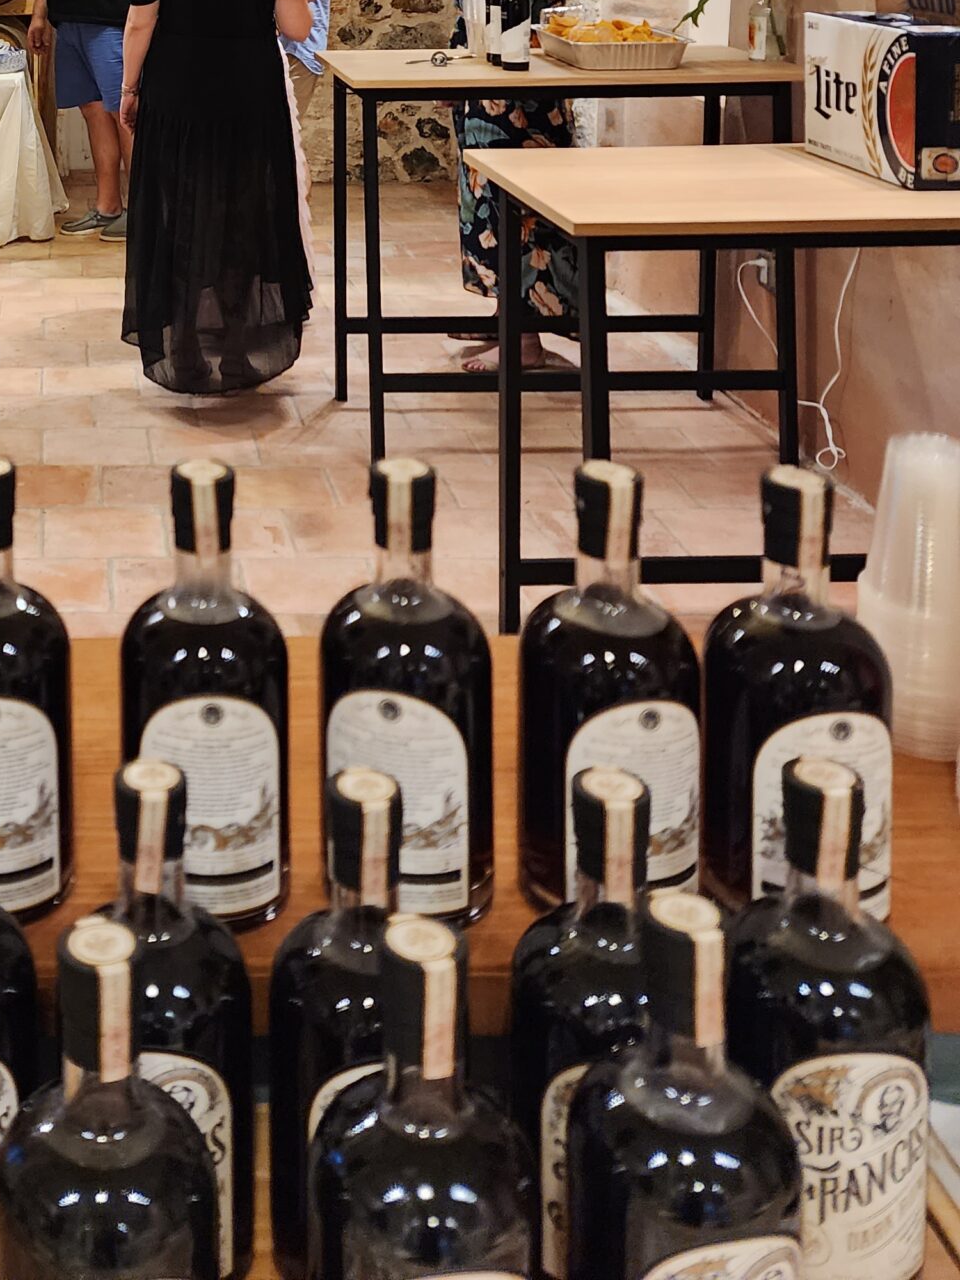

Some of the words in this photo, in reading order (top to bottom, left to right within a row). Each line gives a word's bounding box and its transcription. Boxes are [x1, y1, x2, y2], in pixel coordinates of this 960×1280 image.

[882, 36, 909, 76] FINE
[814, 64, 857, 120] Lite
[878, 81, 889, 96] A
[794, 1119, 863, 1156] SIR
